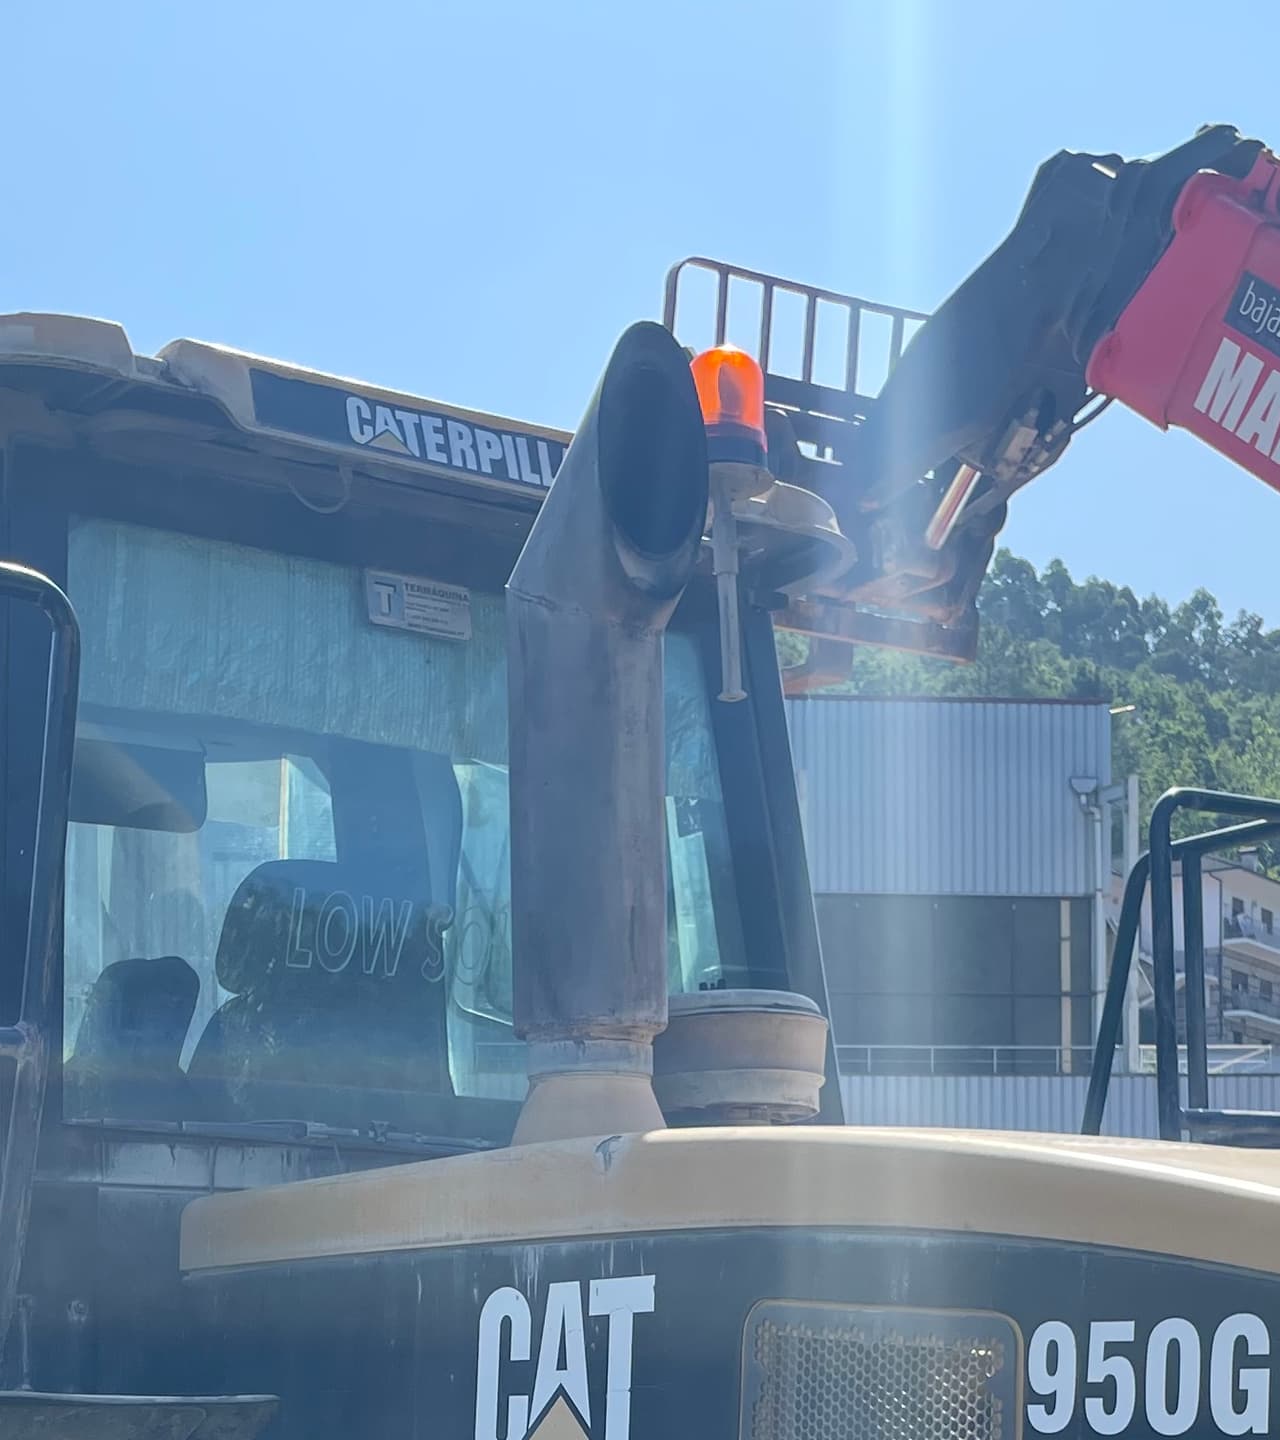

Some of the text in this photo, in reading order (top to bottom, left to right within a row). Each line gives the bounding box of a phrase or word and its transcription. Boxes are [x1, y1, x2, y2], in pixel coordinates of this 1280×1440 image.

[346, 396, 571, 488] CATERPILL
[286, 887, 510, 986] LOW SO
[1026, 1313, 1271, 1436] 950G
